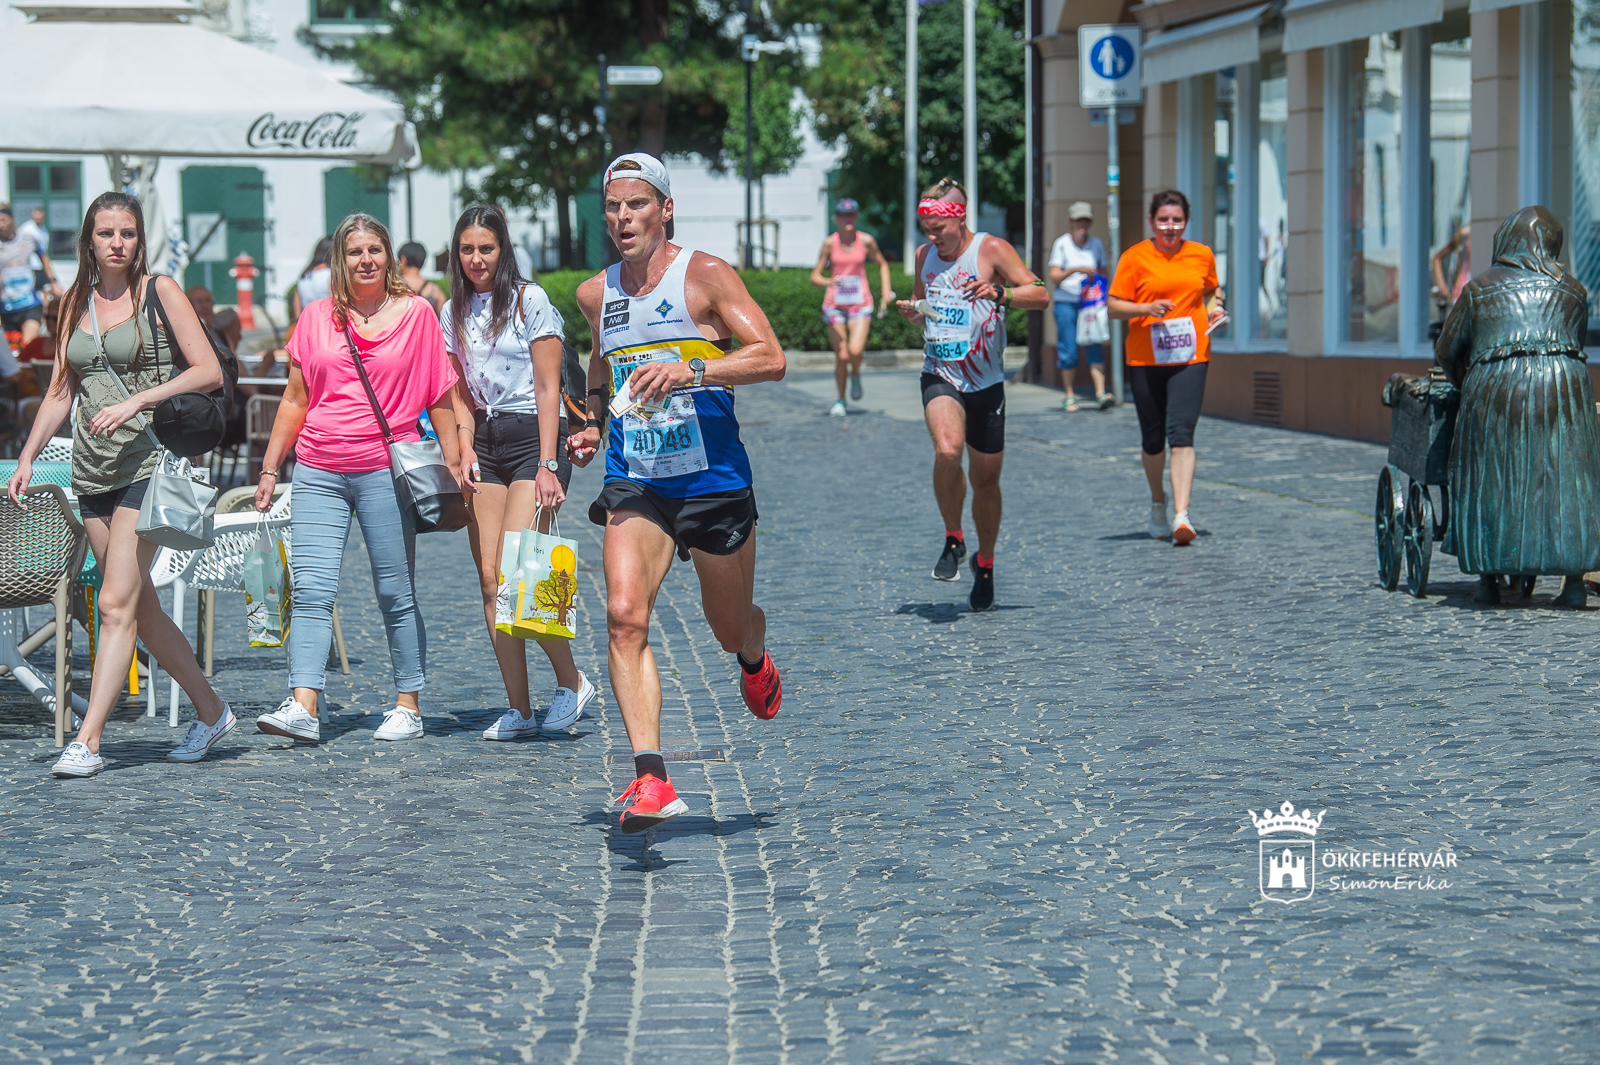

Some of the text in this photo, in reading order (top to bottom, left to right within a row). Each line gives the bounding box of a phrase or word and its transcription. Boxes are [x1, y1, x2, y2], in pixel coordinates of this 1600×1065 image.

[246, 111, 366, 149] Coca-Cola
[1157, 333, 1192, 351] 49550
[633, 423, 692, 454] 40148
[528, 545, 544, 555] Libri
